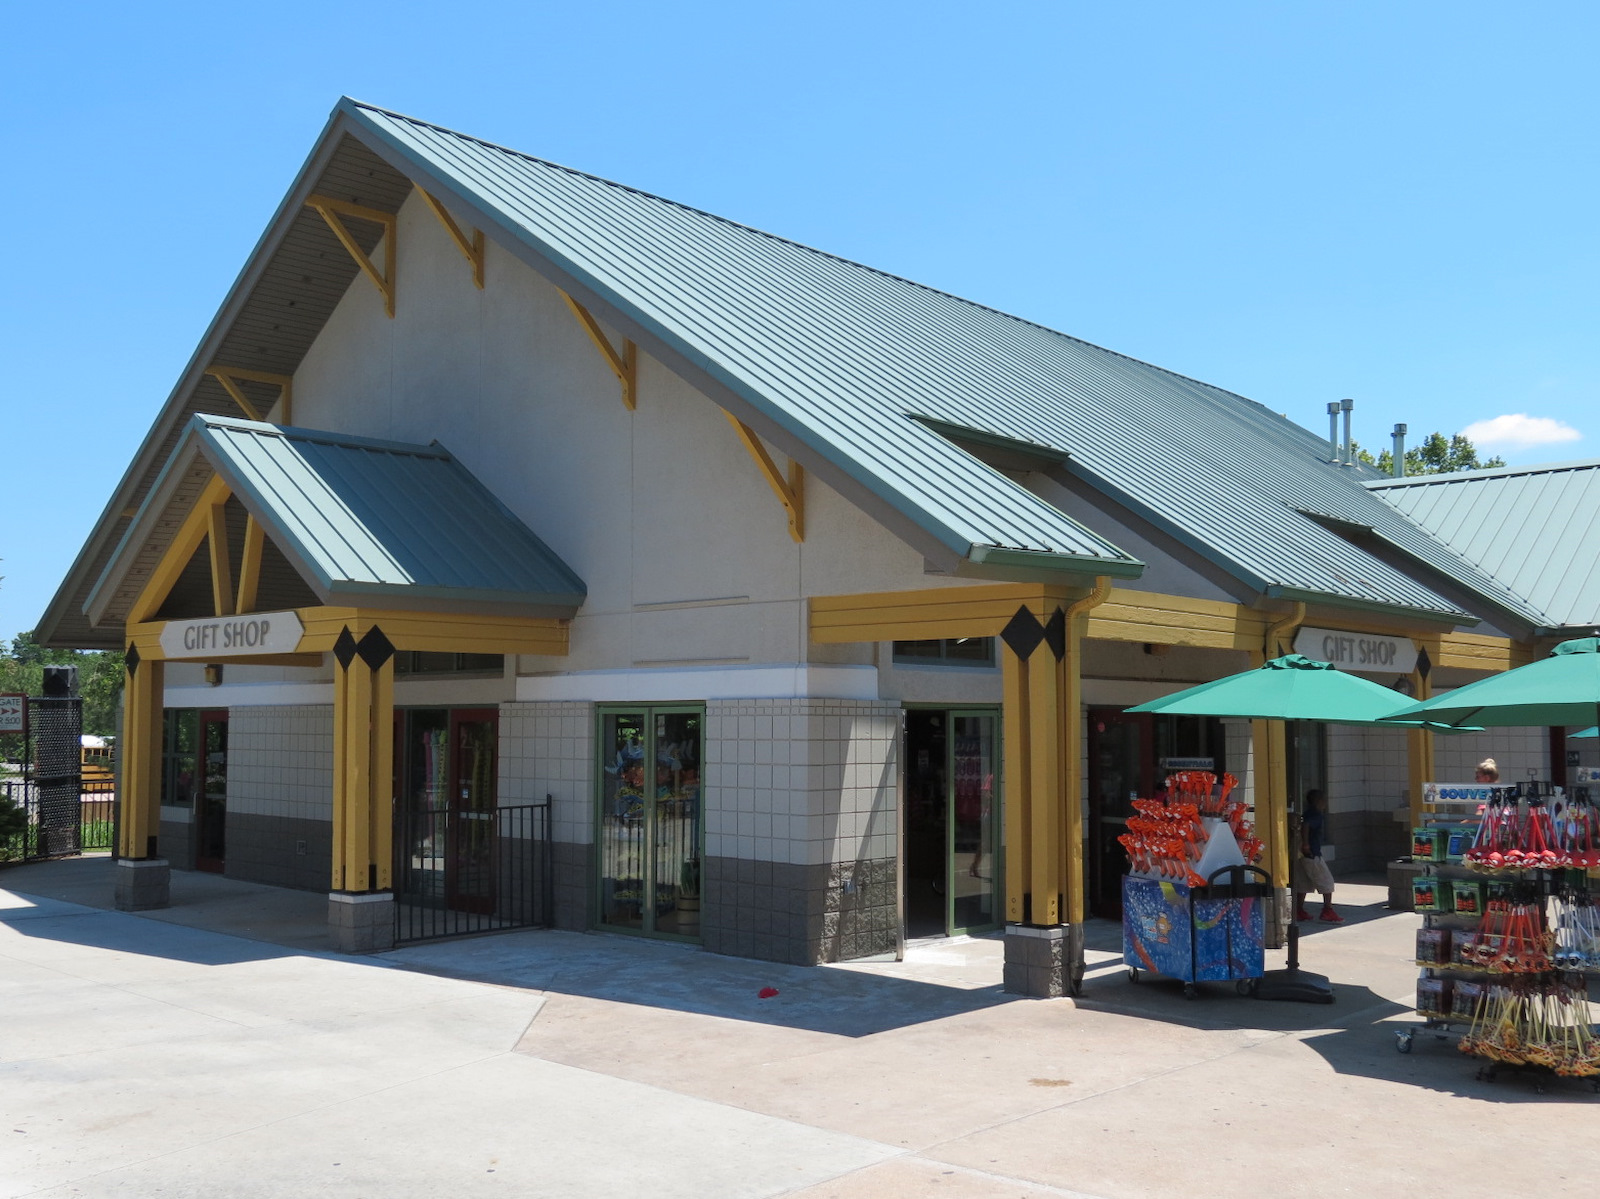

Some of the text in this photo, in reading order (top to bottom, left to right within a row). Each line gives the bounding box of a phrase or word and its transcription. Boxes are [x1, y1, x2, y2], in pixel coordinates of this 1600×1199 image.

[184, 620, 271, 650] GIFT SHOP
[1322, 635, 1397, 665] GIFT SHOP
[0, 698, 21, 706] GATE
